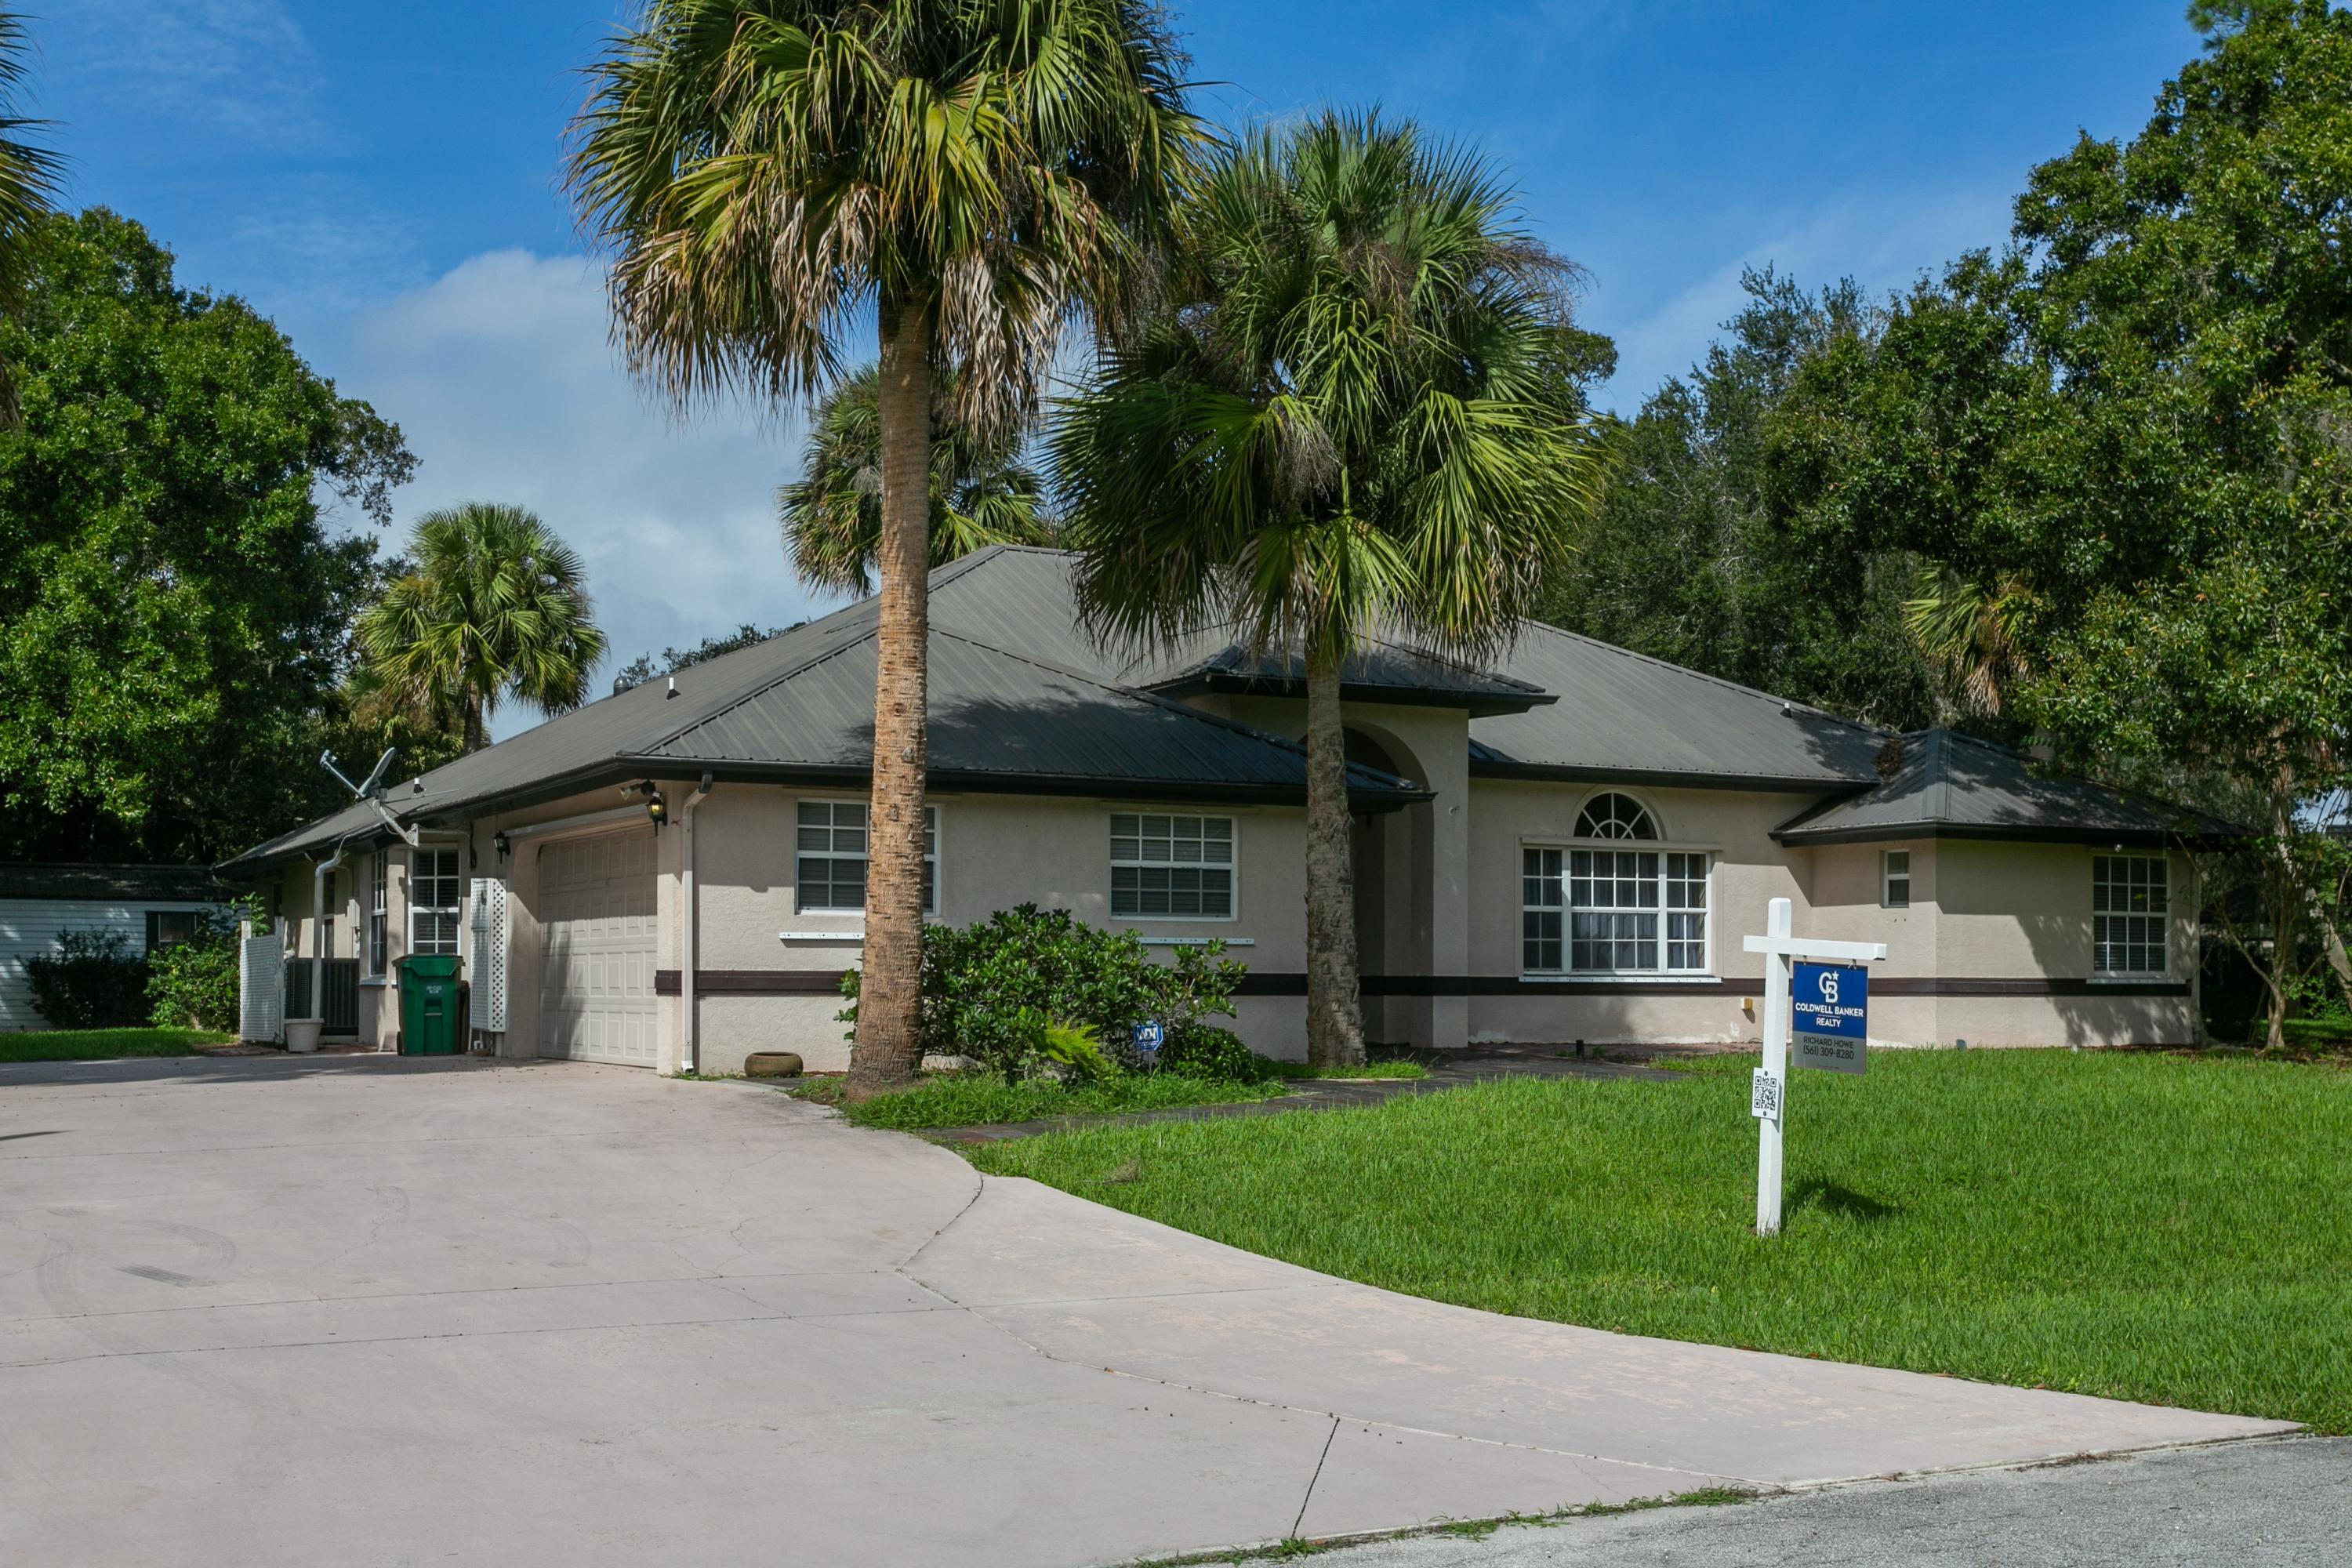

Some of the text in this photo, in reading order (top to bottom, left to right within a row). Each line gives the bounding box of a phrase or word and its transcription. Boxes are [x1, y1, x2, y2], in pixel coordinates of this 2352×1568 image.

[1795, 1003, 1864, 1018] COLDWELL BANKER
[1817, 1018, 1841, 1028] REALTY
[1803, 1036, 1833, 1047] RICHARD
[1803, 1045, 1854, 1060] (561) 309-8280
